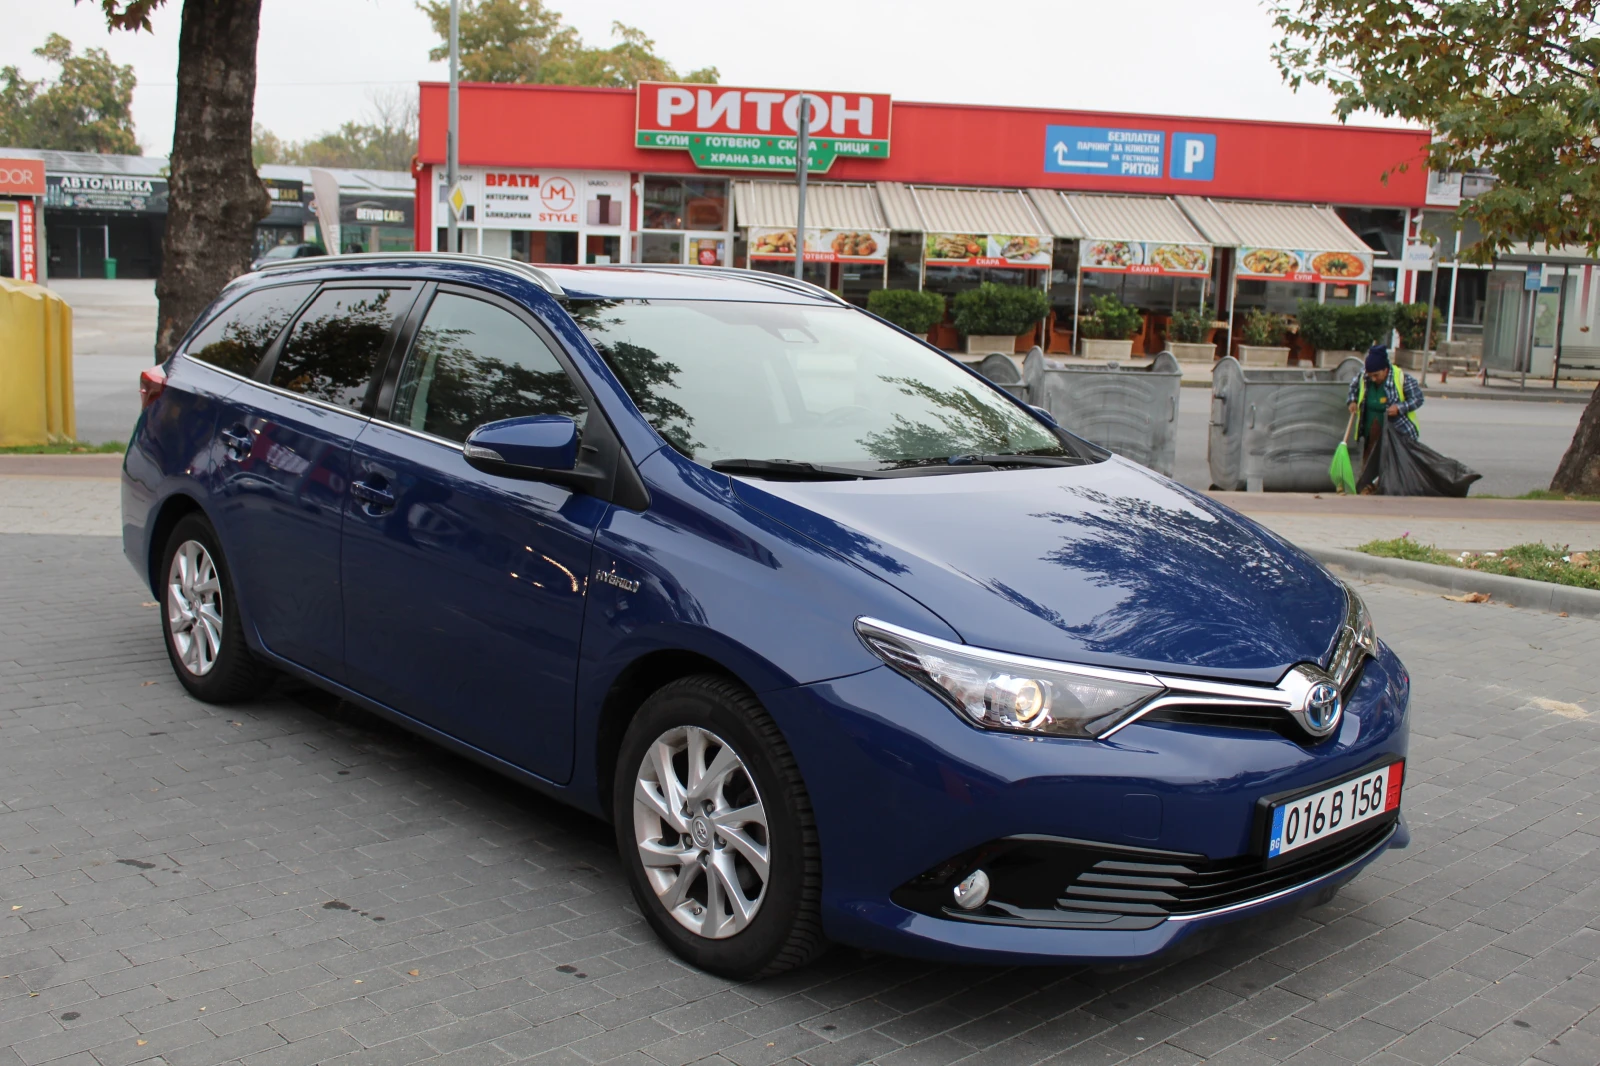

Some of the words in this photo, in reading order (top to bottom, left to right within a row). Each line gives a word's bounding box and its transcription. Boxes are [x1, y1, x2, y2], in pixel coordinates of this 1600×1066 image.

[657, 87, 873, 135] РИТОН
[655, 134, 689, 146] СУПИ
[705, 136, 761, 149] ГОТВЕНО
[777, 139, 817, 151] СКА
[834, 141, 870, 154] ПИЦИ
[1108, 131, 1160, 144] БЕЗПЛАТЕН
[1077, 141, 1111, 151] ПАРКИНГ
[1113, 143, 1123, 152] ЗА
[1125, 144, 1160, 154] КЛИЕНТИ
[710, 153, 750, 164] ХРАНА
[751, 154, 766, 165] ЗА
[768, 155, 813, 166] ВКЪИ
[1122, 162, 1159, 176] РИТОН
[60, 176, 153, 192] АВТОМИВКА
[485, 173, 540, 188] ВРАТИ
[384, 209, 405, 223] CARS
[539, 213, 578, 223] STYLE
[976, 258, 1000, 266] СКАРА
[1131, 265, 1160, 273] САЛАТИ
[1270, 837, 1281, 851] BG
[1286, 797, 1326, 845] 016
[1329, 790, 1344, 829] B
[1351, 774, 1383, 820] 158
